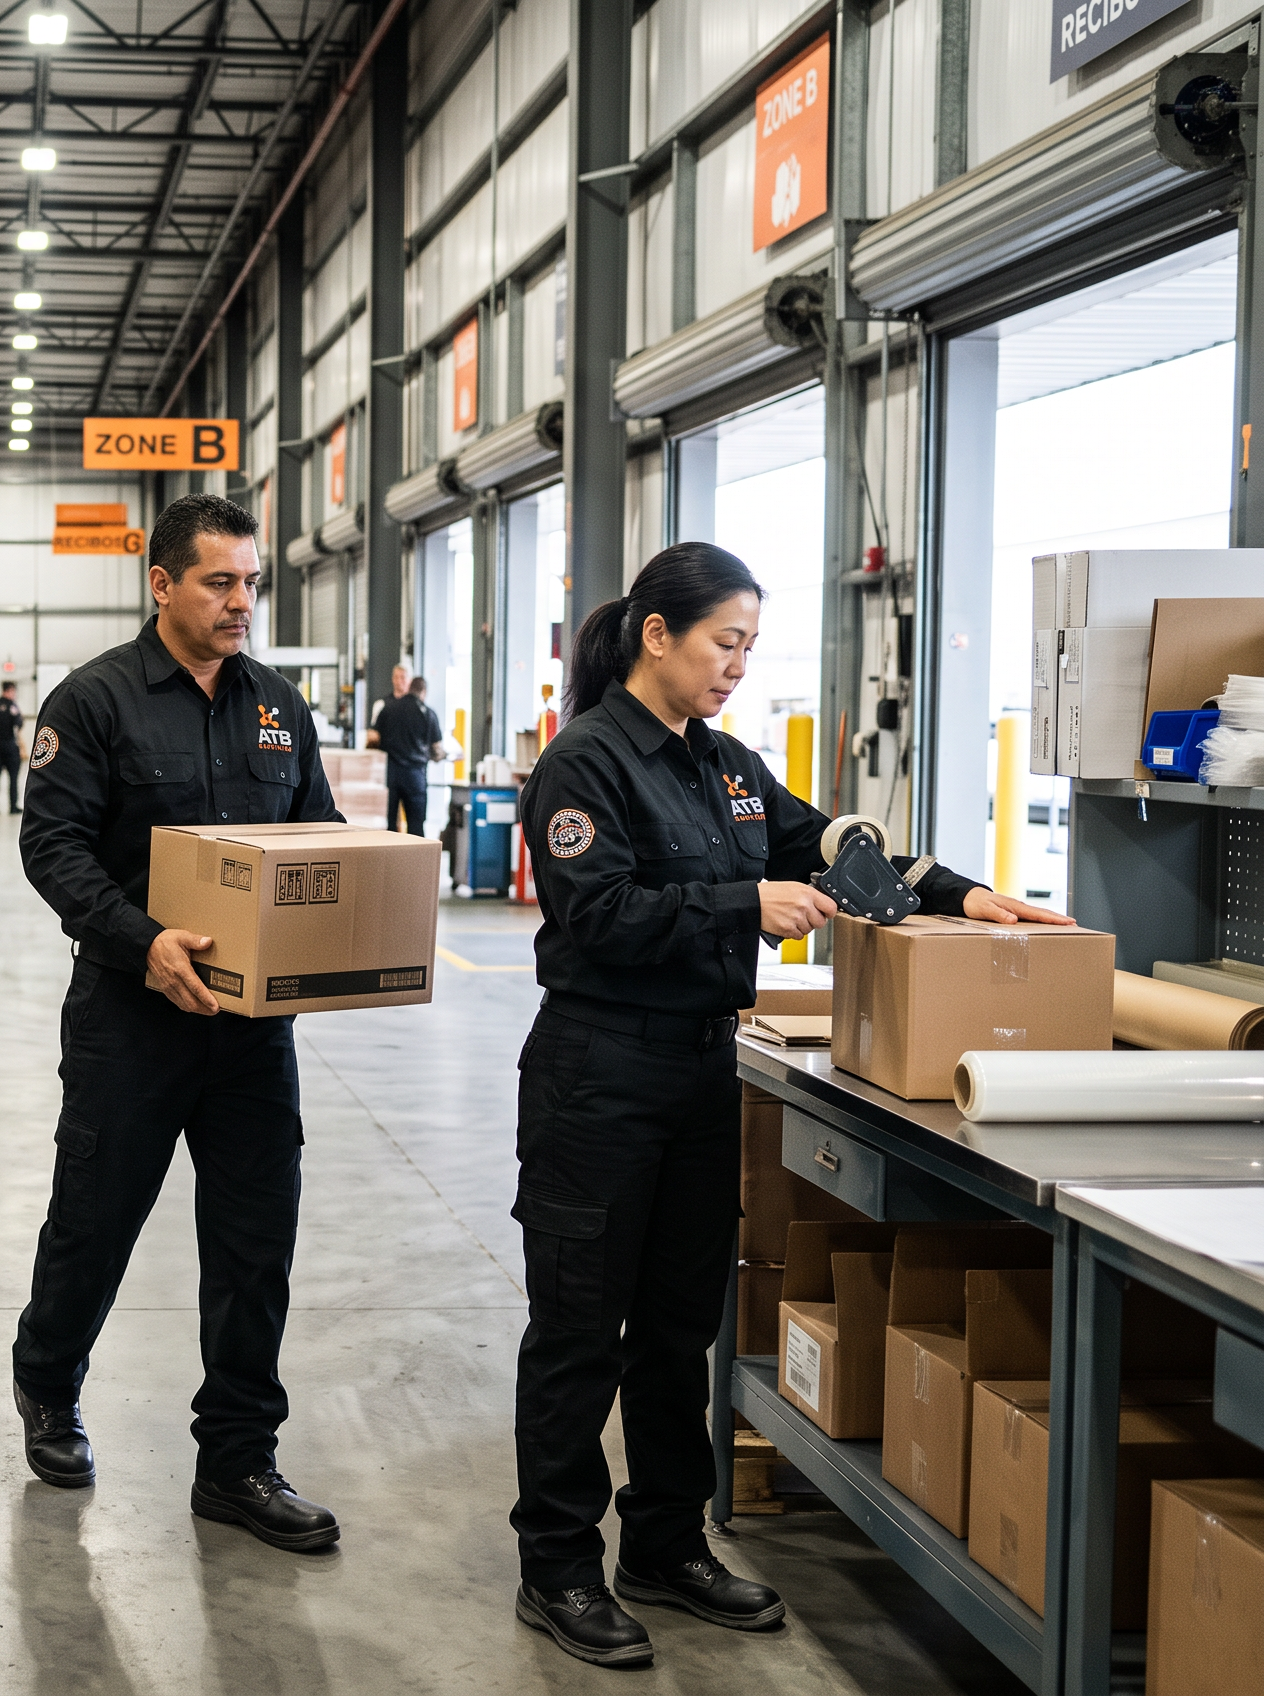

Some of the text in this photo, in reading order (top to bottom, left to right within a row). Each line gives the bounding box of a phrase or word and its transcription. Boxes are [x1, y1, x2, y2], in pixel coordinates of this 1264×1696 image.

[1061, 0, 1138, 53] RECIB
[762, 67, 818, 139] ZONE B
[95, 425, 226, 464] ZONE B
[124, 532, 141, 554] G
[258, 728, 292, 746] ATB
[730, 796, 764, 816] ATB
